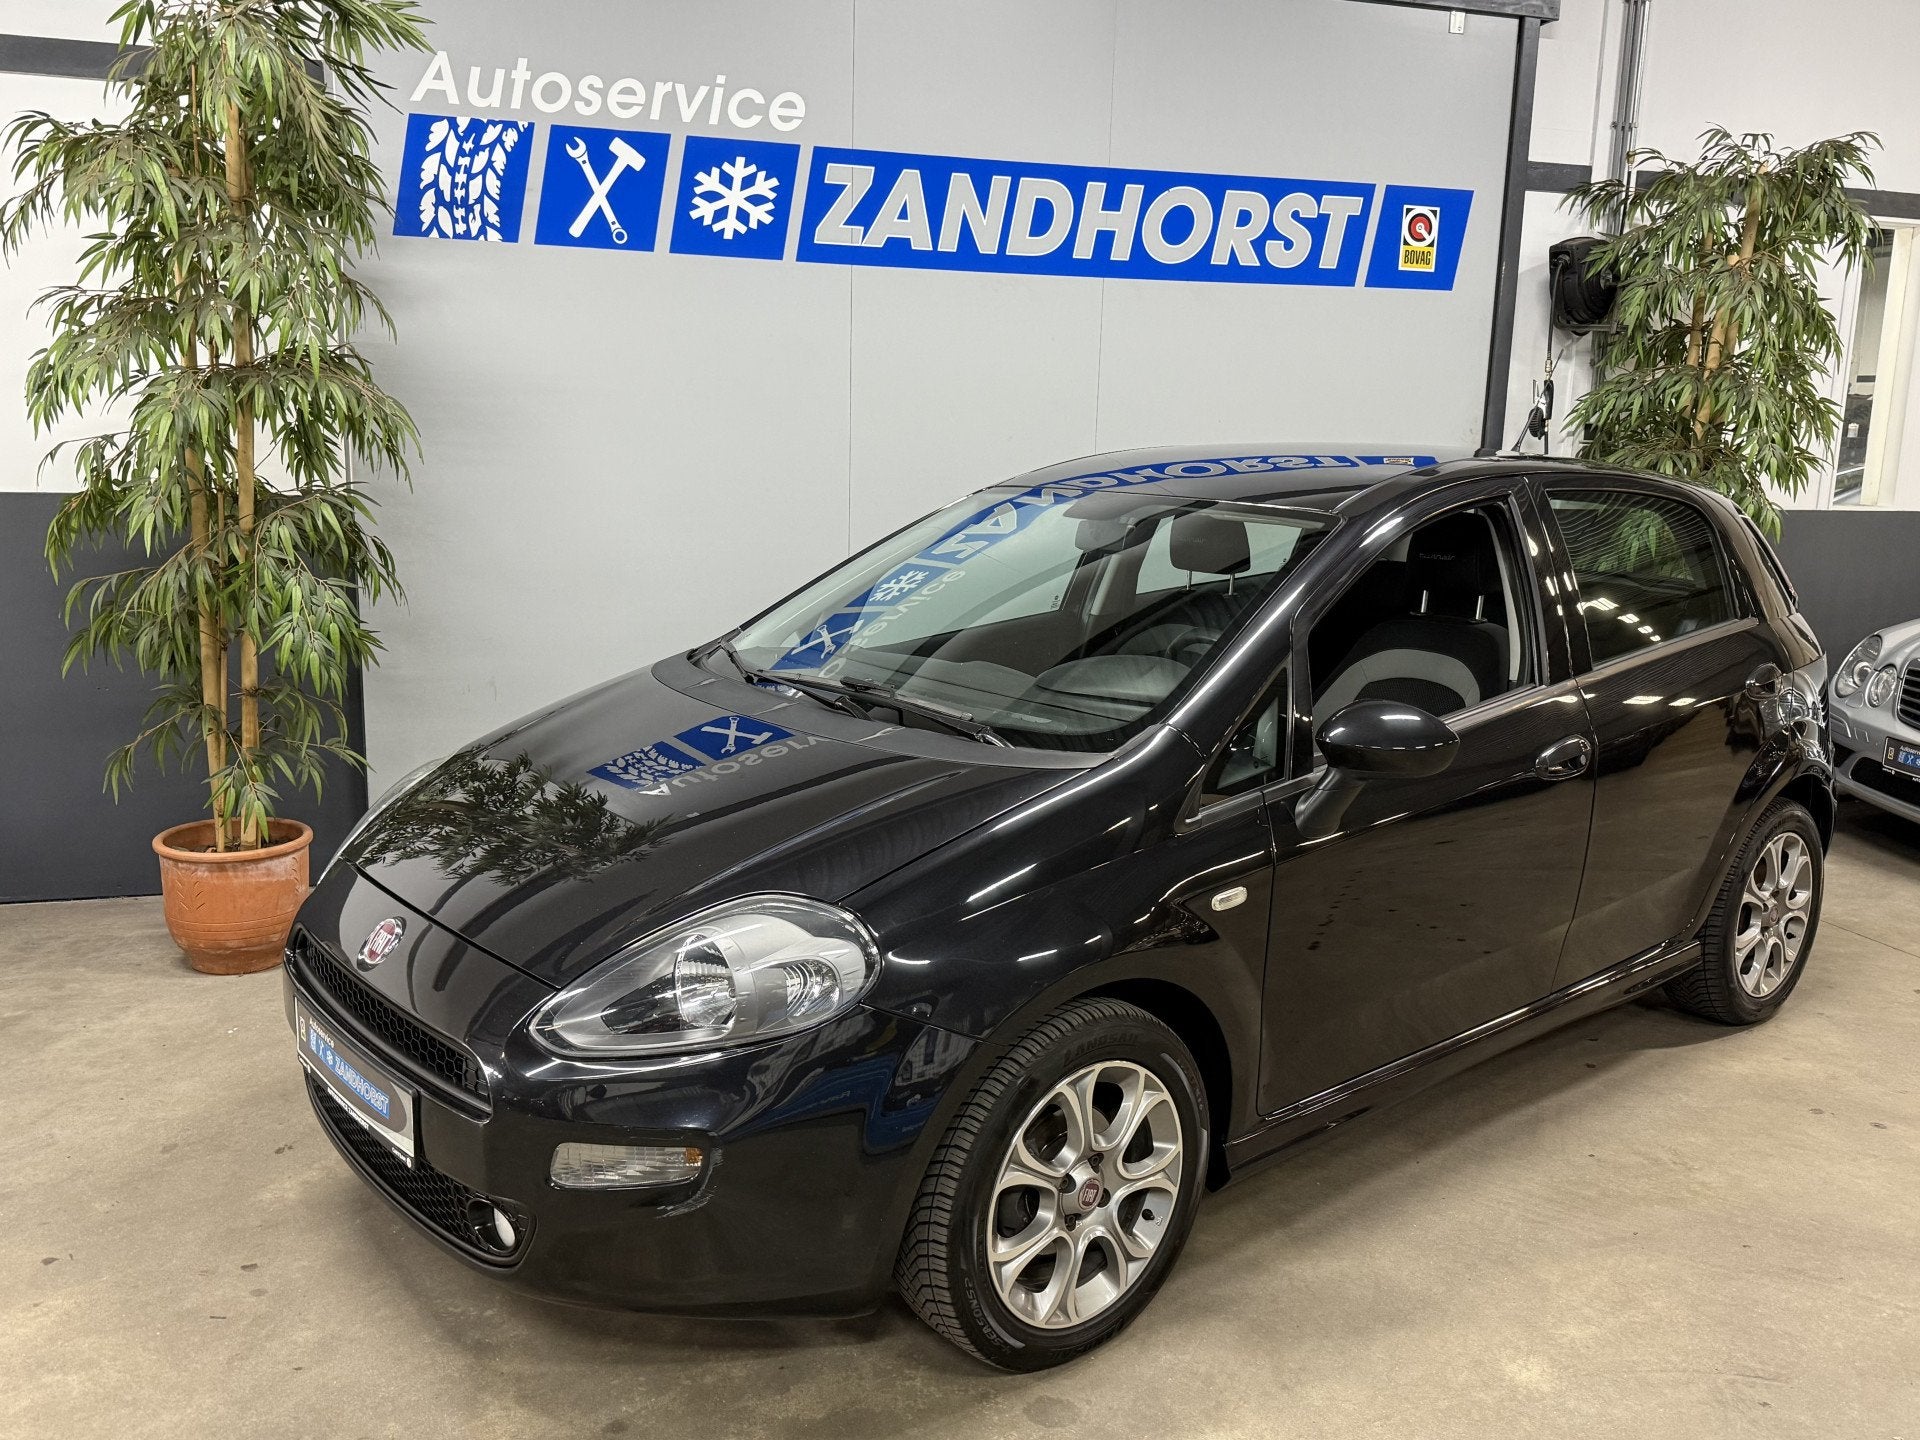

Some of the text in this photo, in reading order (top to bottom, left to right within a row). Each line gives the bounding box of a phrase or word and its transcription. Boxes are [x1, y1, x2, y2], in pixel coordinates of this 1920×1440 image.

[410, 50, 807, 132] Autoservice
[813, 162, 1364, 270] ZANDHORST
[1404, 249, 1432, 266] BOVAG
[370, 929, 394, 955] FIAT
[335, 1056, 389, 1114] ZANDHORST
[1082, 1188, 1098, 1203] FIAT
